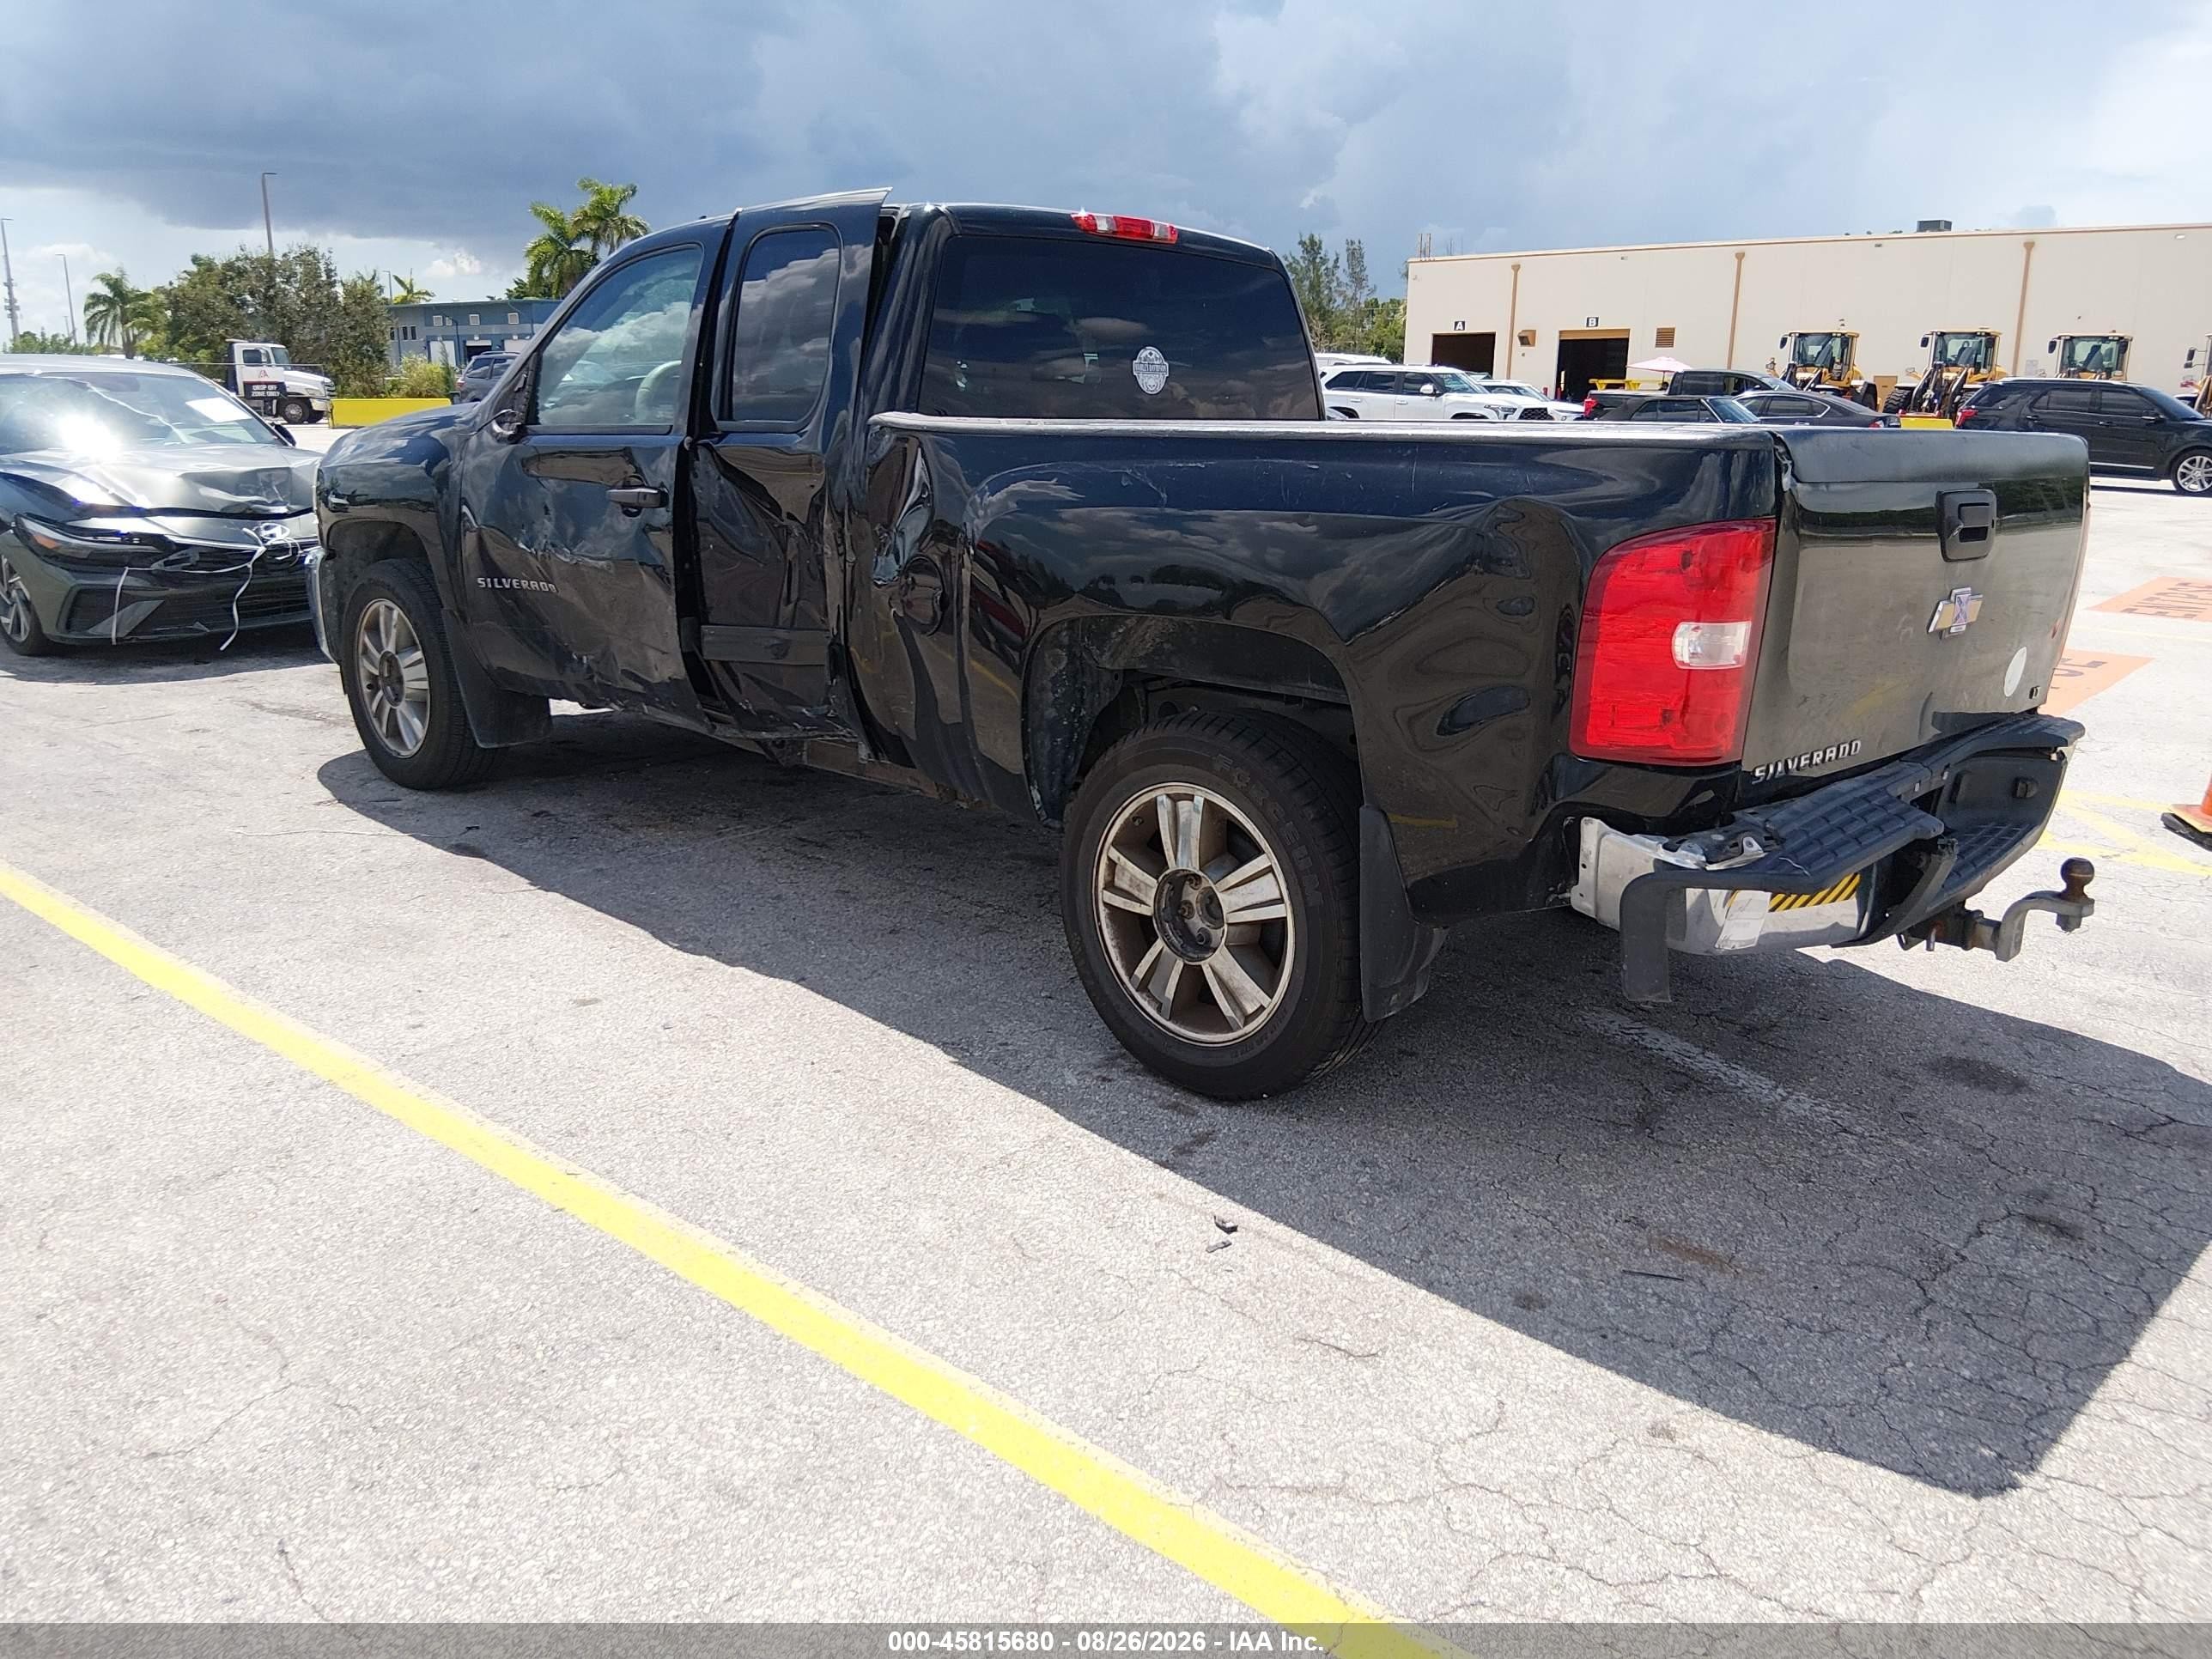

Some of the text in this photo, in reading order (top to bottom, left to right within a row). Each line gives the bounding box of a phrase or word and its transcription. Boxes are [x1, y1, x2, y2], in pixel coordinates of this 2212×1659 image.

[1455, 321, 1464, 331] A
[1588, 318, 1597, 327] B
[477, 577, 558, 592] SILVERADO
[1751, 738, 1862, 785] SILVERADO
